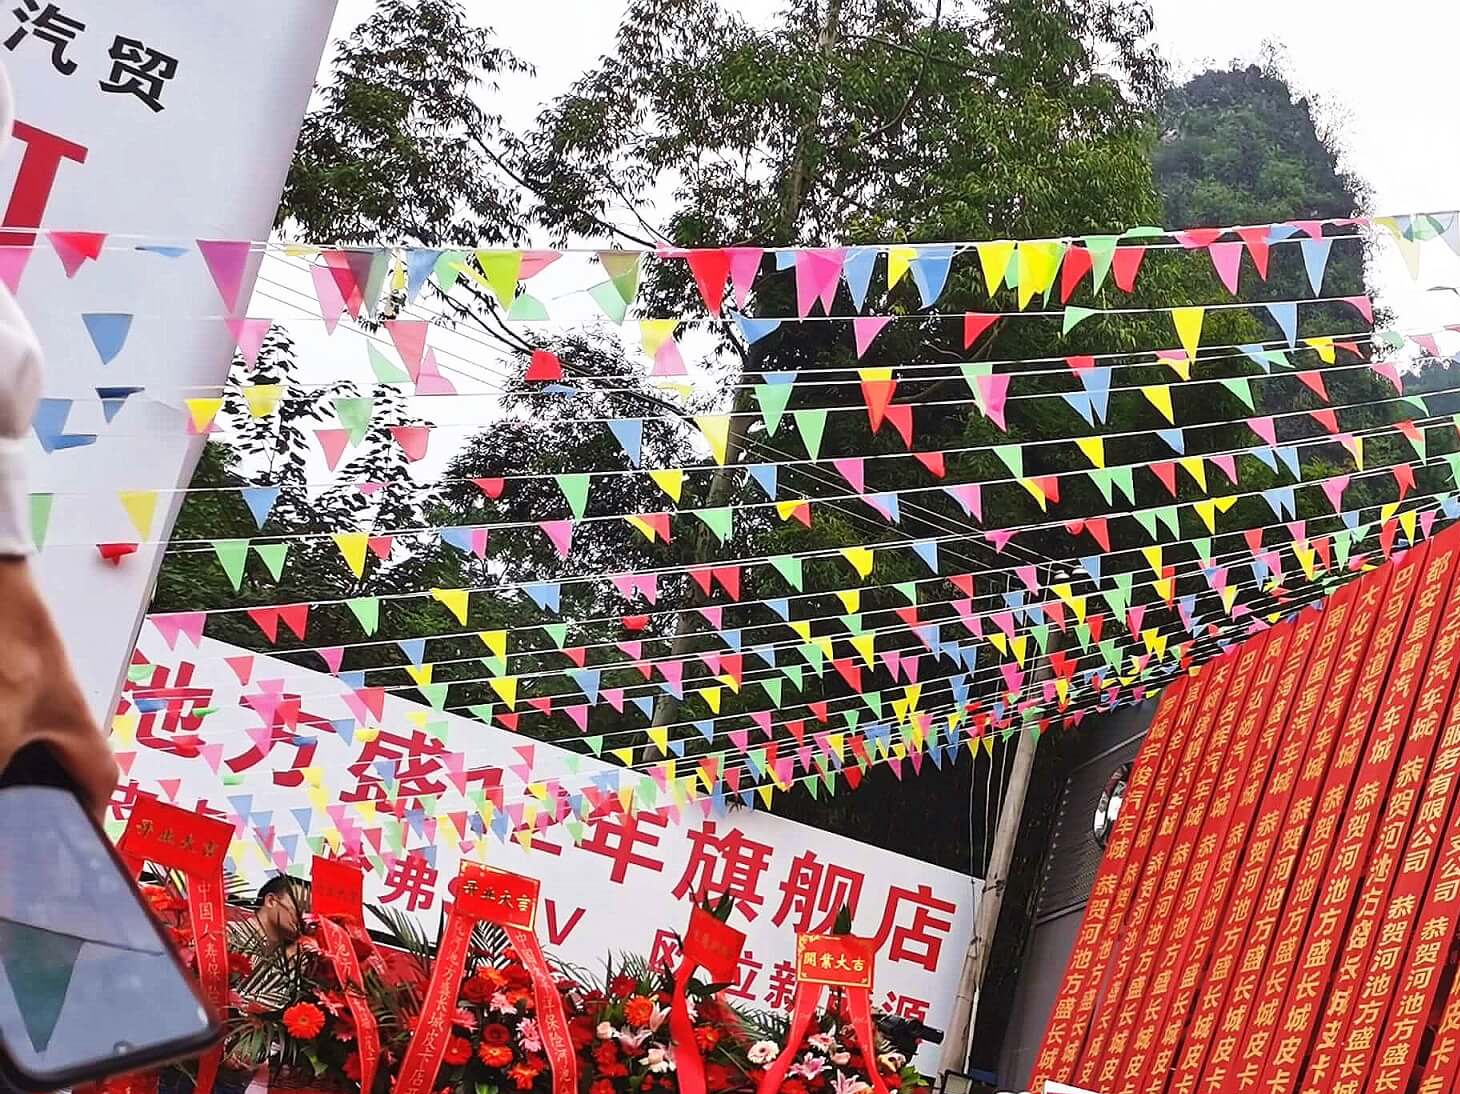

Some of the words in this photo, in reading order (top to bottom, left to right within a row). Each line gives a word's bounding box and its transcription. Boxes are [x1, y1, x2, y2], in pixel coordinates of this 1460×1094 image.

[3, 0, 179, 113] 汽贸
[801, 951, 866, 973] 開業大吉
